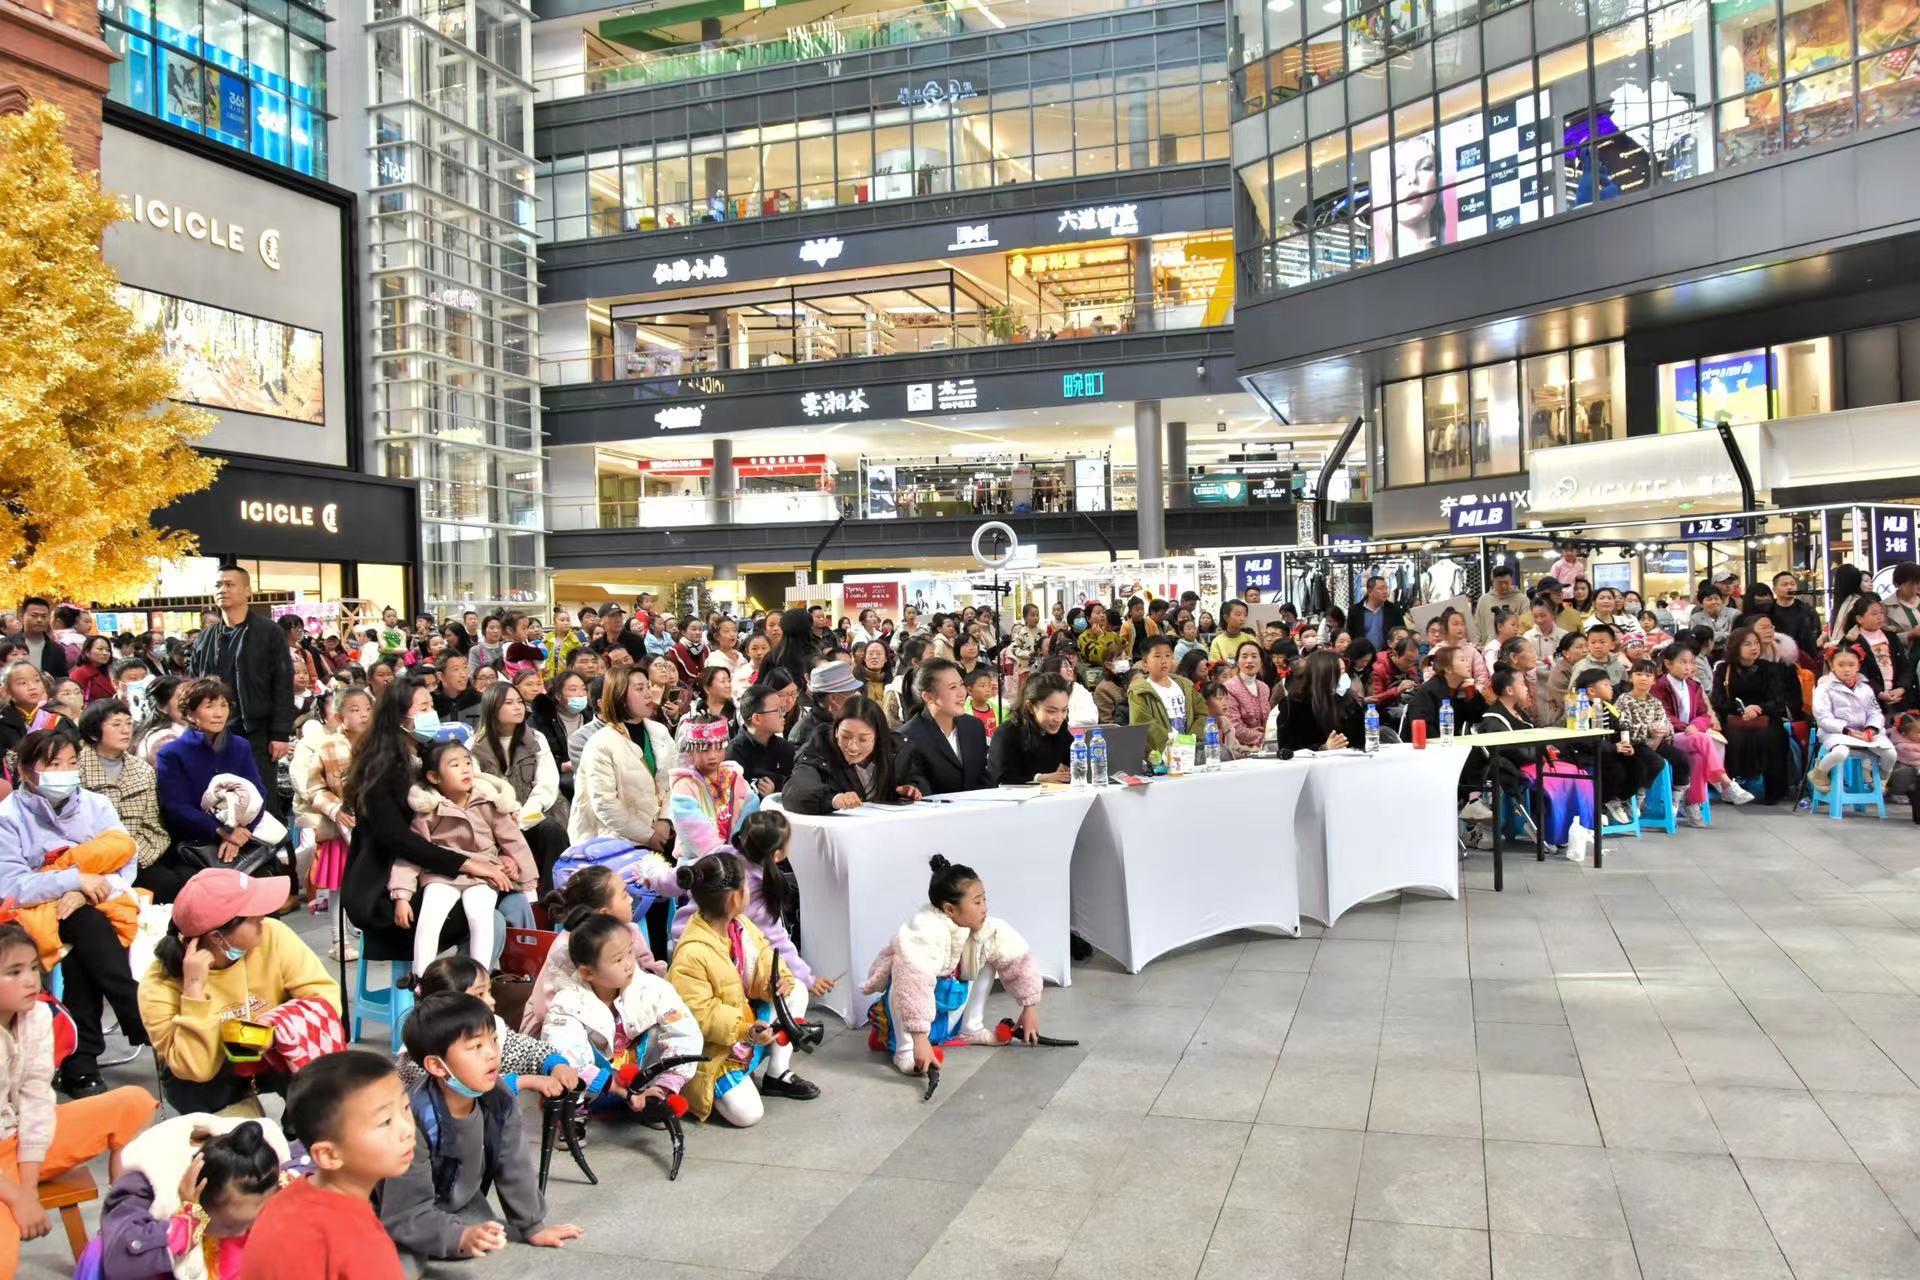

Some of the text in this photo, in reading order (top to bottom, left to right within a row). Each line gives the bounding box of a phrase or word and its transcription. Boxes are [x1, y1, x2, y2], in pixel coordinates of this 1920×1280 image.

[1493, 115, 1510, 126] Dior
[134, 194, 245, 253] ICICLE
[938, 379, 977, 397] 太二
[241, 500, 314, 526] ICICLE
[1457, 507, 1503, 528] MLB
[1883, 516, 1908, 532] MLB
[1333, 539, 1362, 553] MLB
[1244, 559, 1272, 572] MLB
